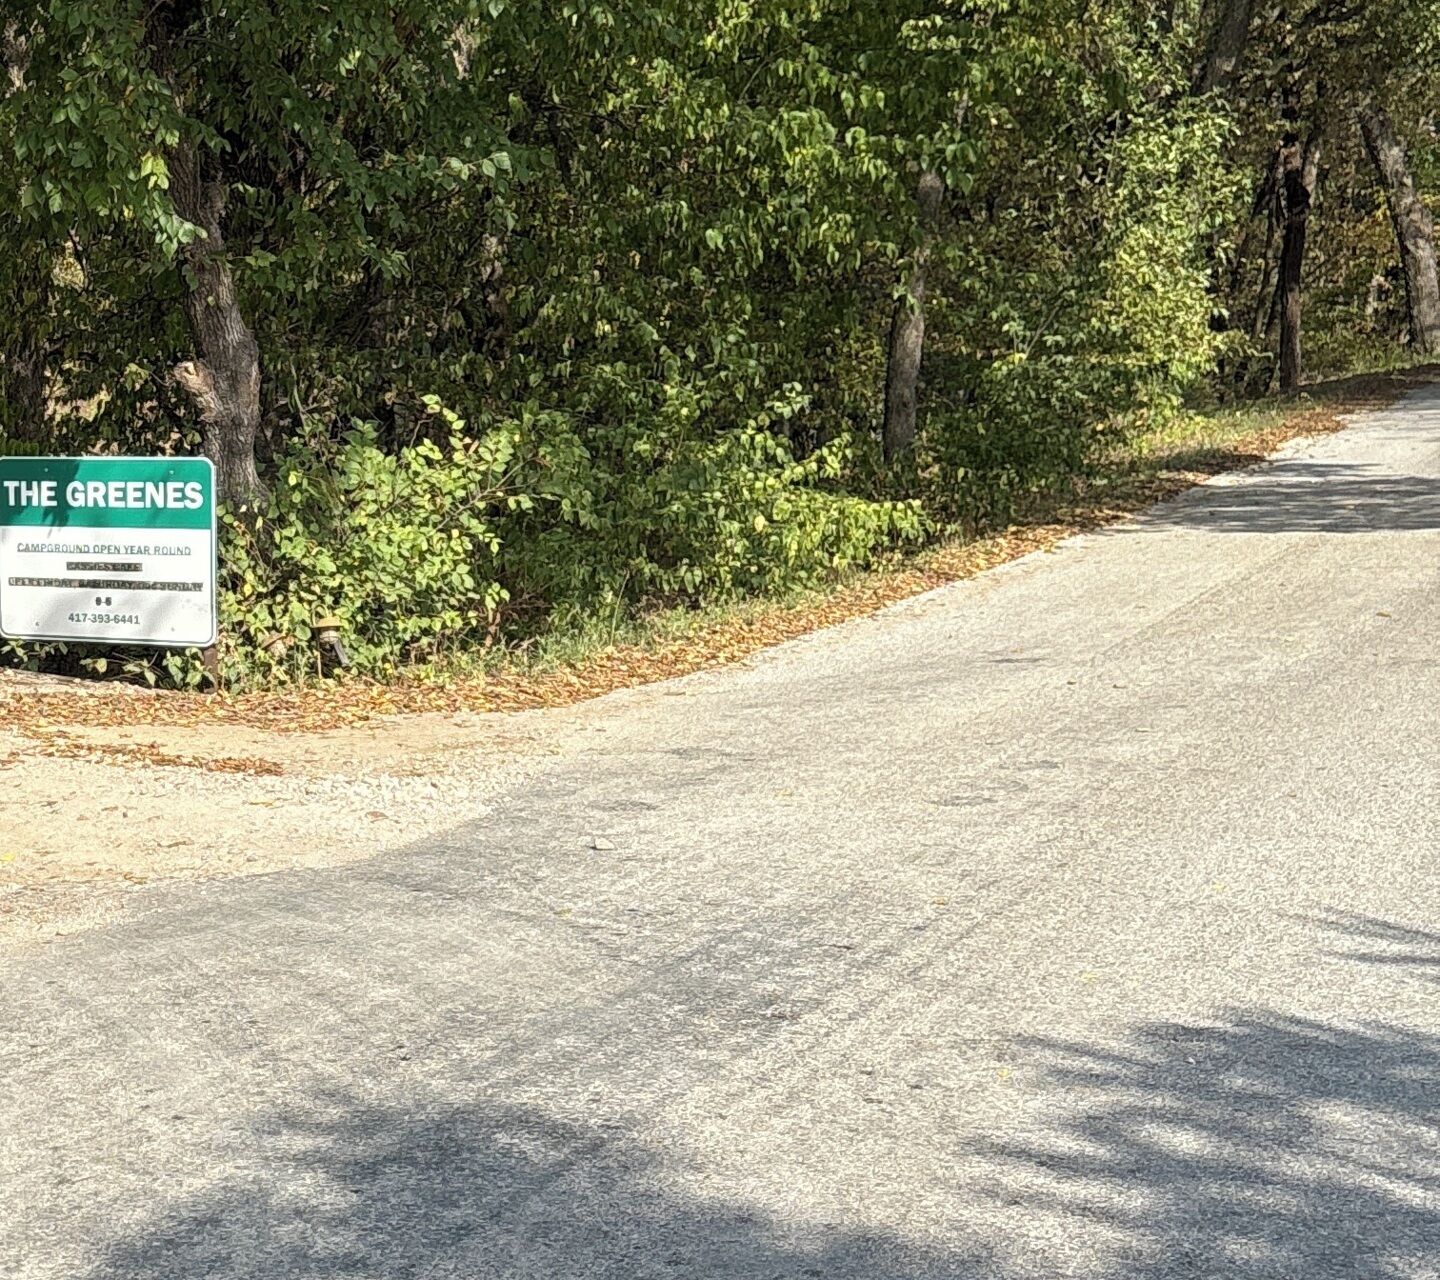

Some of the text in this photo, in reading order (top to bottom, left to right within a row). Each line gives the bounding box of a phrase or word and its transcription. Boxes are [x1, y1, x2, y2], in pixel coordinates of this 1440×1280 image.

[3, 480, 204, 510] THE GREENES
[16, 542, 192, 556] CAMPGROUND OPEN YEAR ROUND
[68, 613, 141, 625] 417-393-6441
